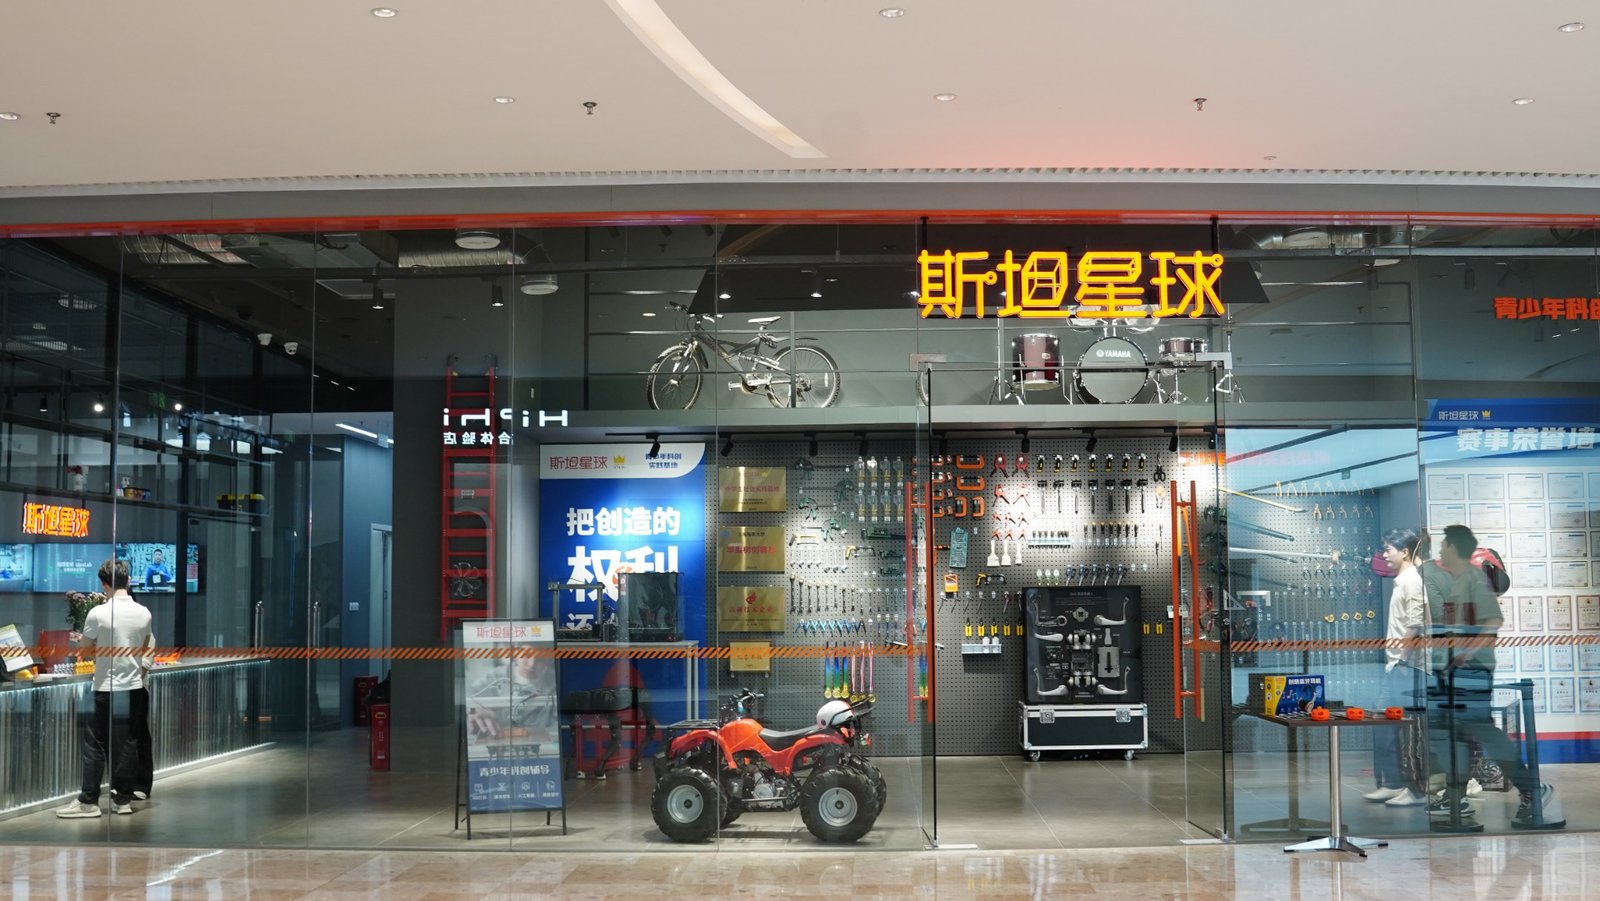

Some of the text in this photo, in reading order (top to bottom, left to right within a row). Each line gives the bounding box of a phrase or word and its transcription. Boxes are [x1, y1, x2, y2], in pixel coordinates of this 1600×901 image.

[917, 249, 1226, 319] 斯坦星球
[1104, 349, 1131, 358] YAMAHA
[1438, 410, 1478, 420] 斯坦星球
[1456, 427, 1596, 452] 赛事荣誉墙
[549, 456, 608, 470] 斯坦星球
[23, 502, 90, 537] 斯坦星球
[566, 506, 681, 536] 把创造的
[476, 625, 527, 638] 斯坦星球
